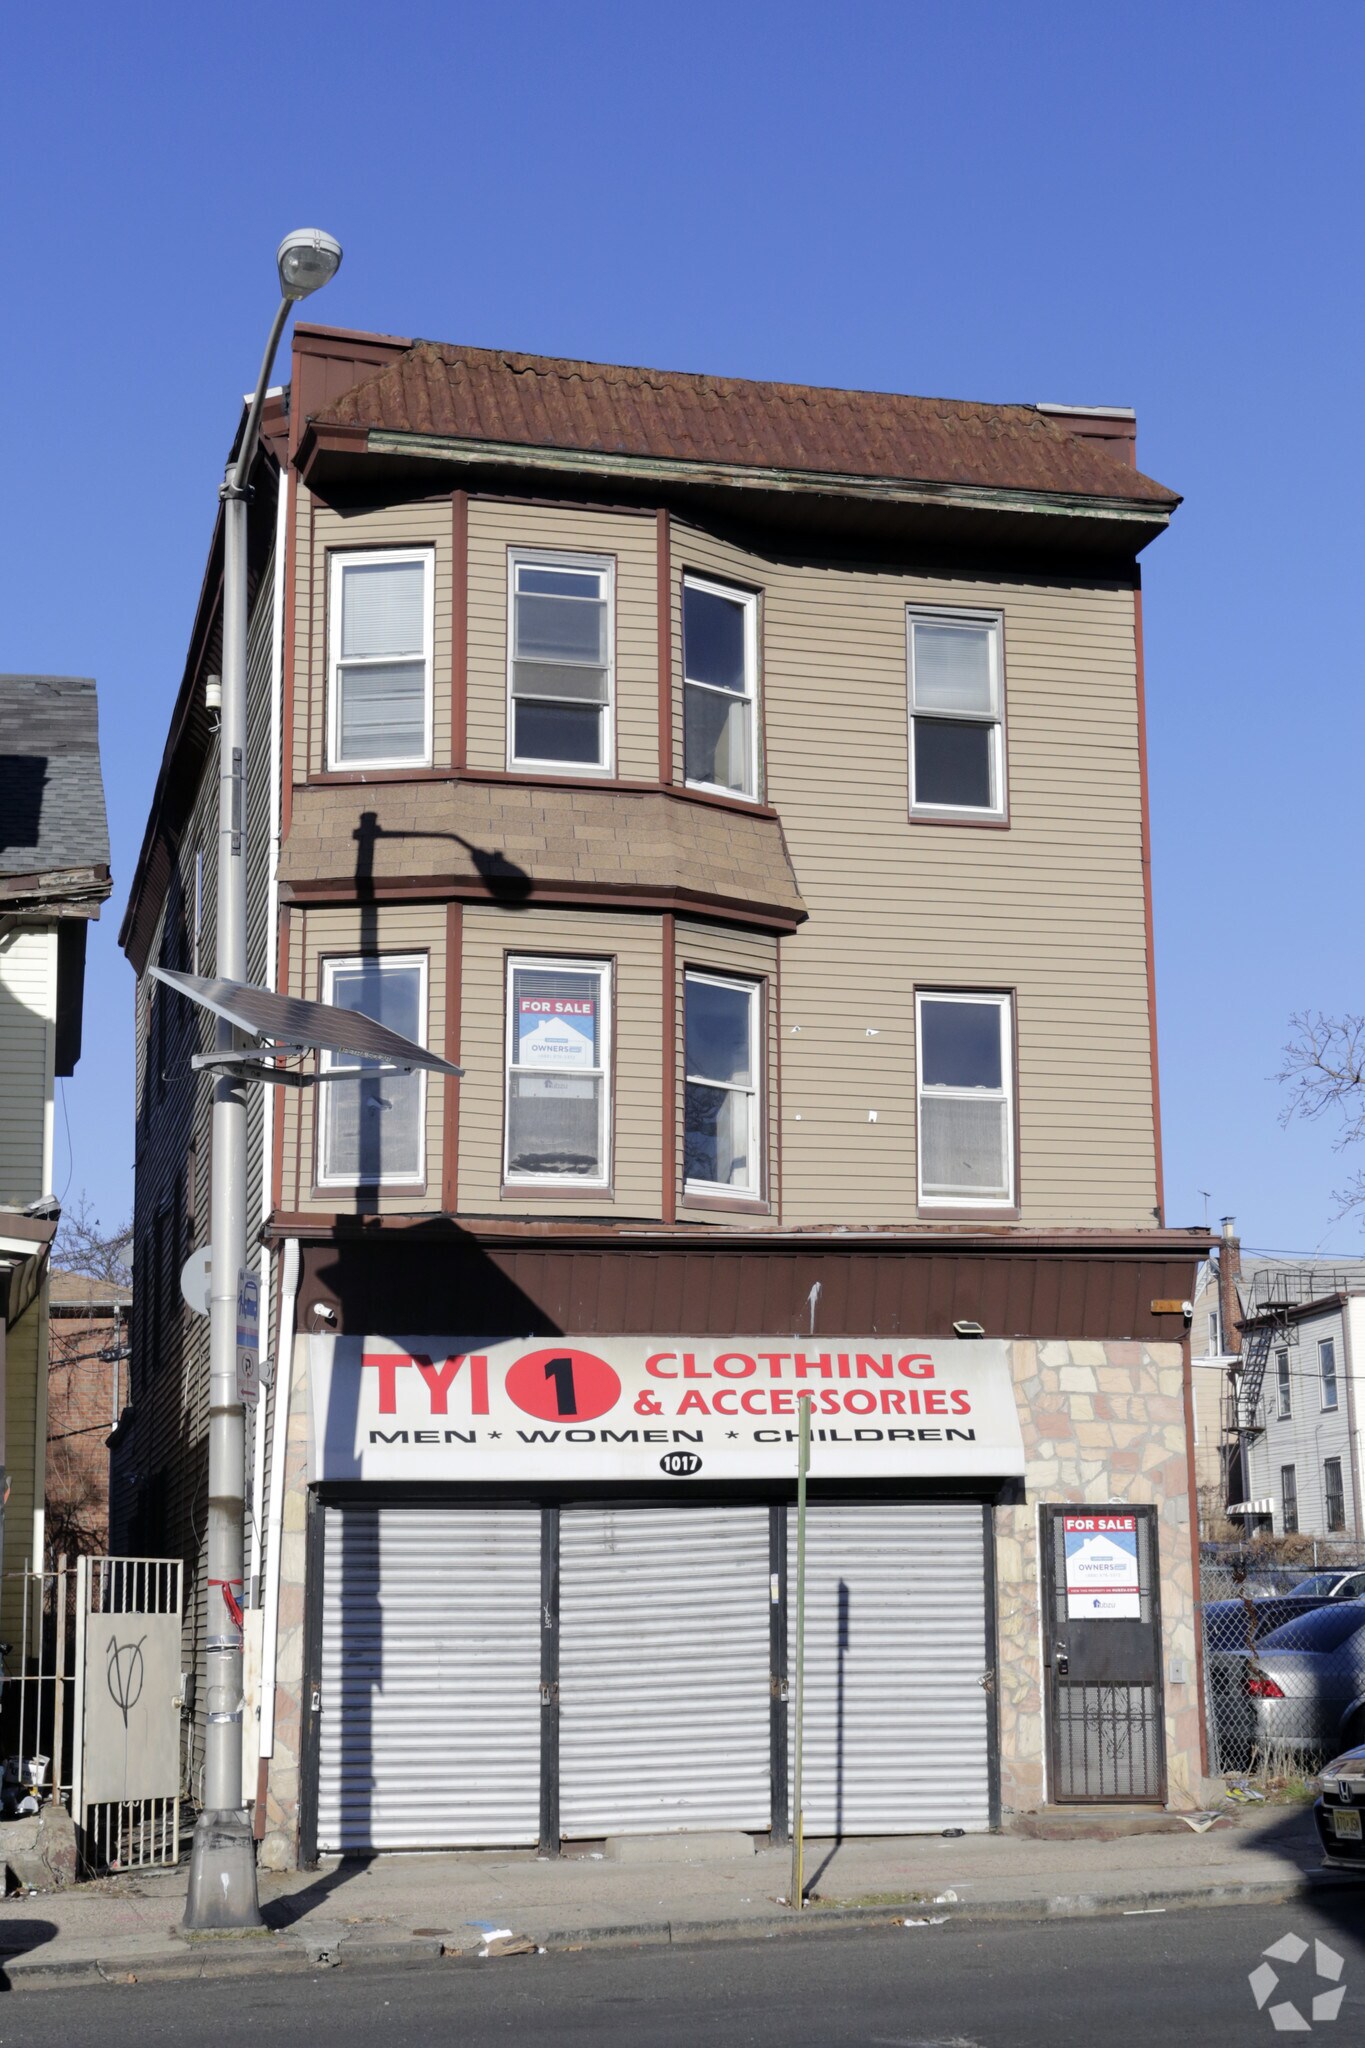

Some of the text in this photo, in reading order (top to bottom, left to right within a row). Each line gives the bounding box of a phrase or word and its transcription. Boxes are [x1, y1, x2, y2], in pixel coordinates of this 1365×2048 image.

[522, 1001, 591, 1014] FOR SALE
[531, 1044, 569, 1053] OWNERS
[645, 1353, 935, 1379] CLOTHING
[361, 1354, 577, 1416] TYI 1
[633, 1388, 972, 1416] & ACCESSORIES
[369, 1430, 477, 1443] MEN
[516, 1429, 704, 1443] WOMEN
[753, 1428, 976, 1443] CHILDREN
[663, 1455, 699, 1472] 1017
[1066, 1519, 1133, 1530] FOR SALE
